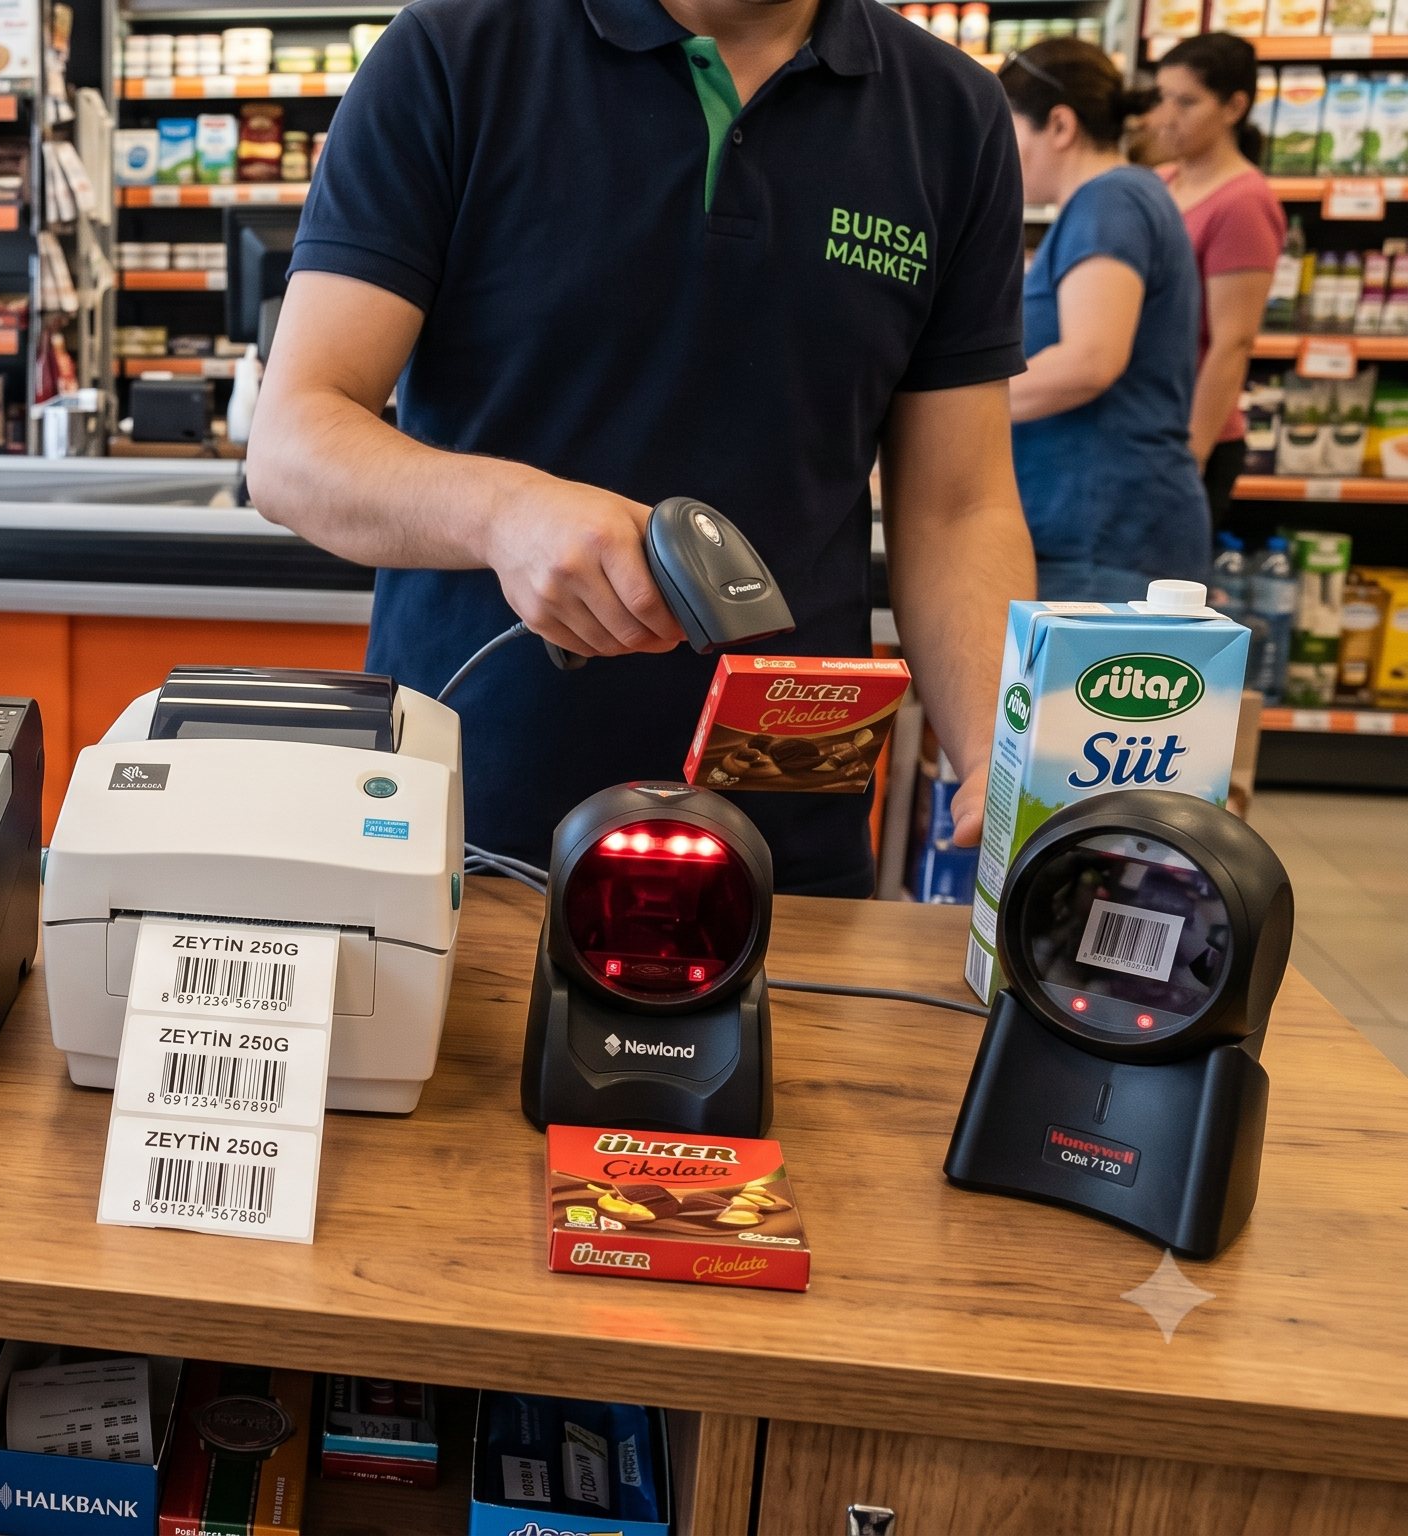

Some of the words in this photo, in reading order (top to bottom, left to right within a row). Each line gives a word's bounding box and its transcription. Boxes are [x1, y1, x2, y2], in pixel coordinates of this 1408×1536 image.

[831, 207, 928, 260] BURSA
[825, 238, 927, 286] MARKET
[765, 677, 861, 703] ÜLKER
[1088, 665, 1189, 709] sütaş
[758, 703, 849, 732] Çikolata
[1067, 731, 1188, 790] Süt
[172, 934, 244, 954] ZEYTİN
[249, 939, 299, 956] 250G
[161, 992, 169, 1003] 8
[235, 998, 287, 1012] 567890
[158, 1027, 233, 1049] ZEYTİN
[238, 1034, 290, 1053] 250G
[624, 1039, 696, 1060] Newland
[147, 1092, 156, 1103] 8
[224, 1098, 278, 1114] 567890
[144, 1130, 221, 1153] ZEYTİN
[226, 1138, 279, 1158] 250G
[594, 1133, 740, 1165] ÜLKER
[602, 1158, 732, 1180] Çikolata
[1091, 1156, 1121, 1176] 7120
[132, 1199, 141, 1211] 8
[211, 1207, 267, 1224] 567880
[569, 1242, 651, 1270] ÜLKER
[692, 1253, 769, 1280] Çikolata
[15, 1489, 139, 1519] HALKBANK
